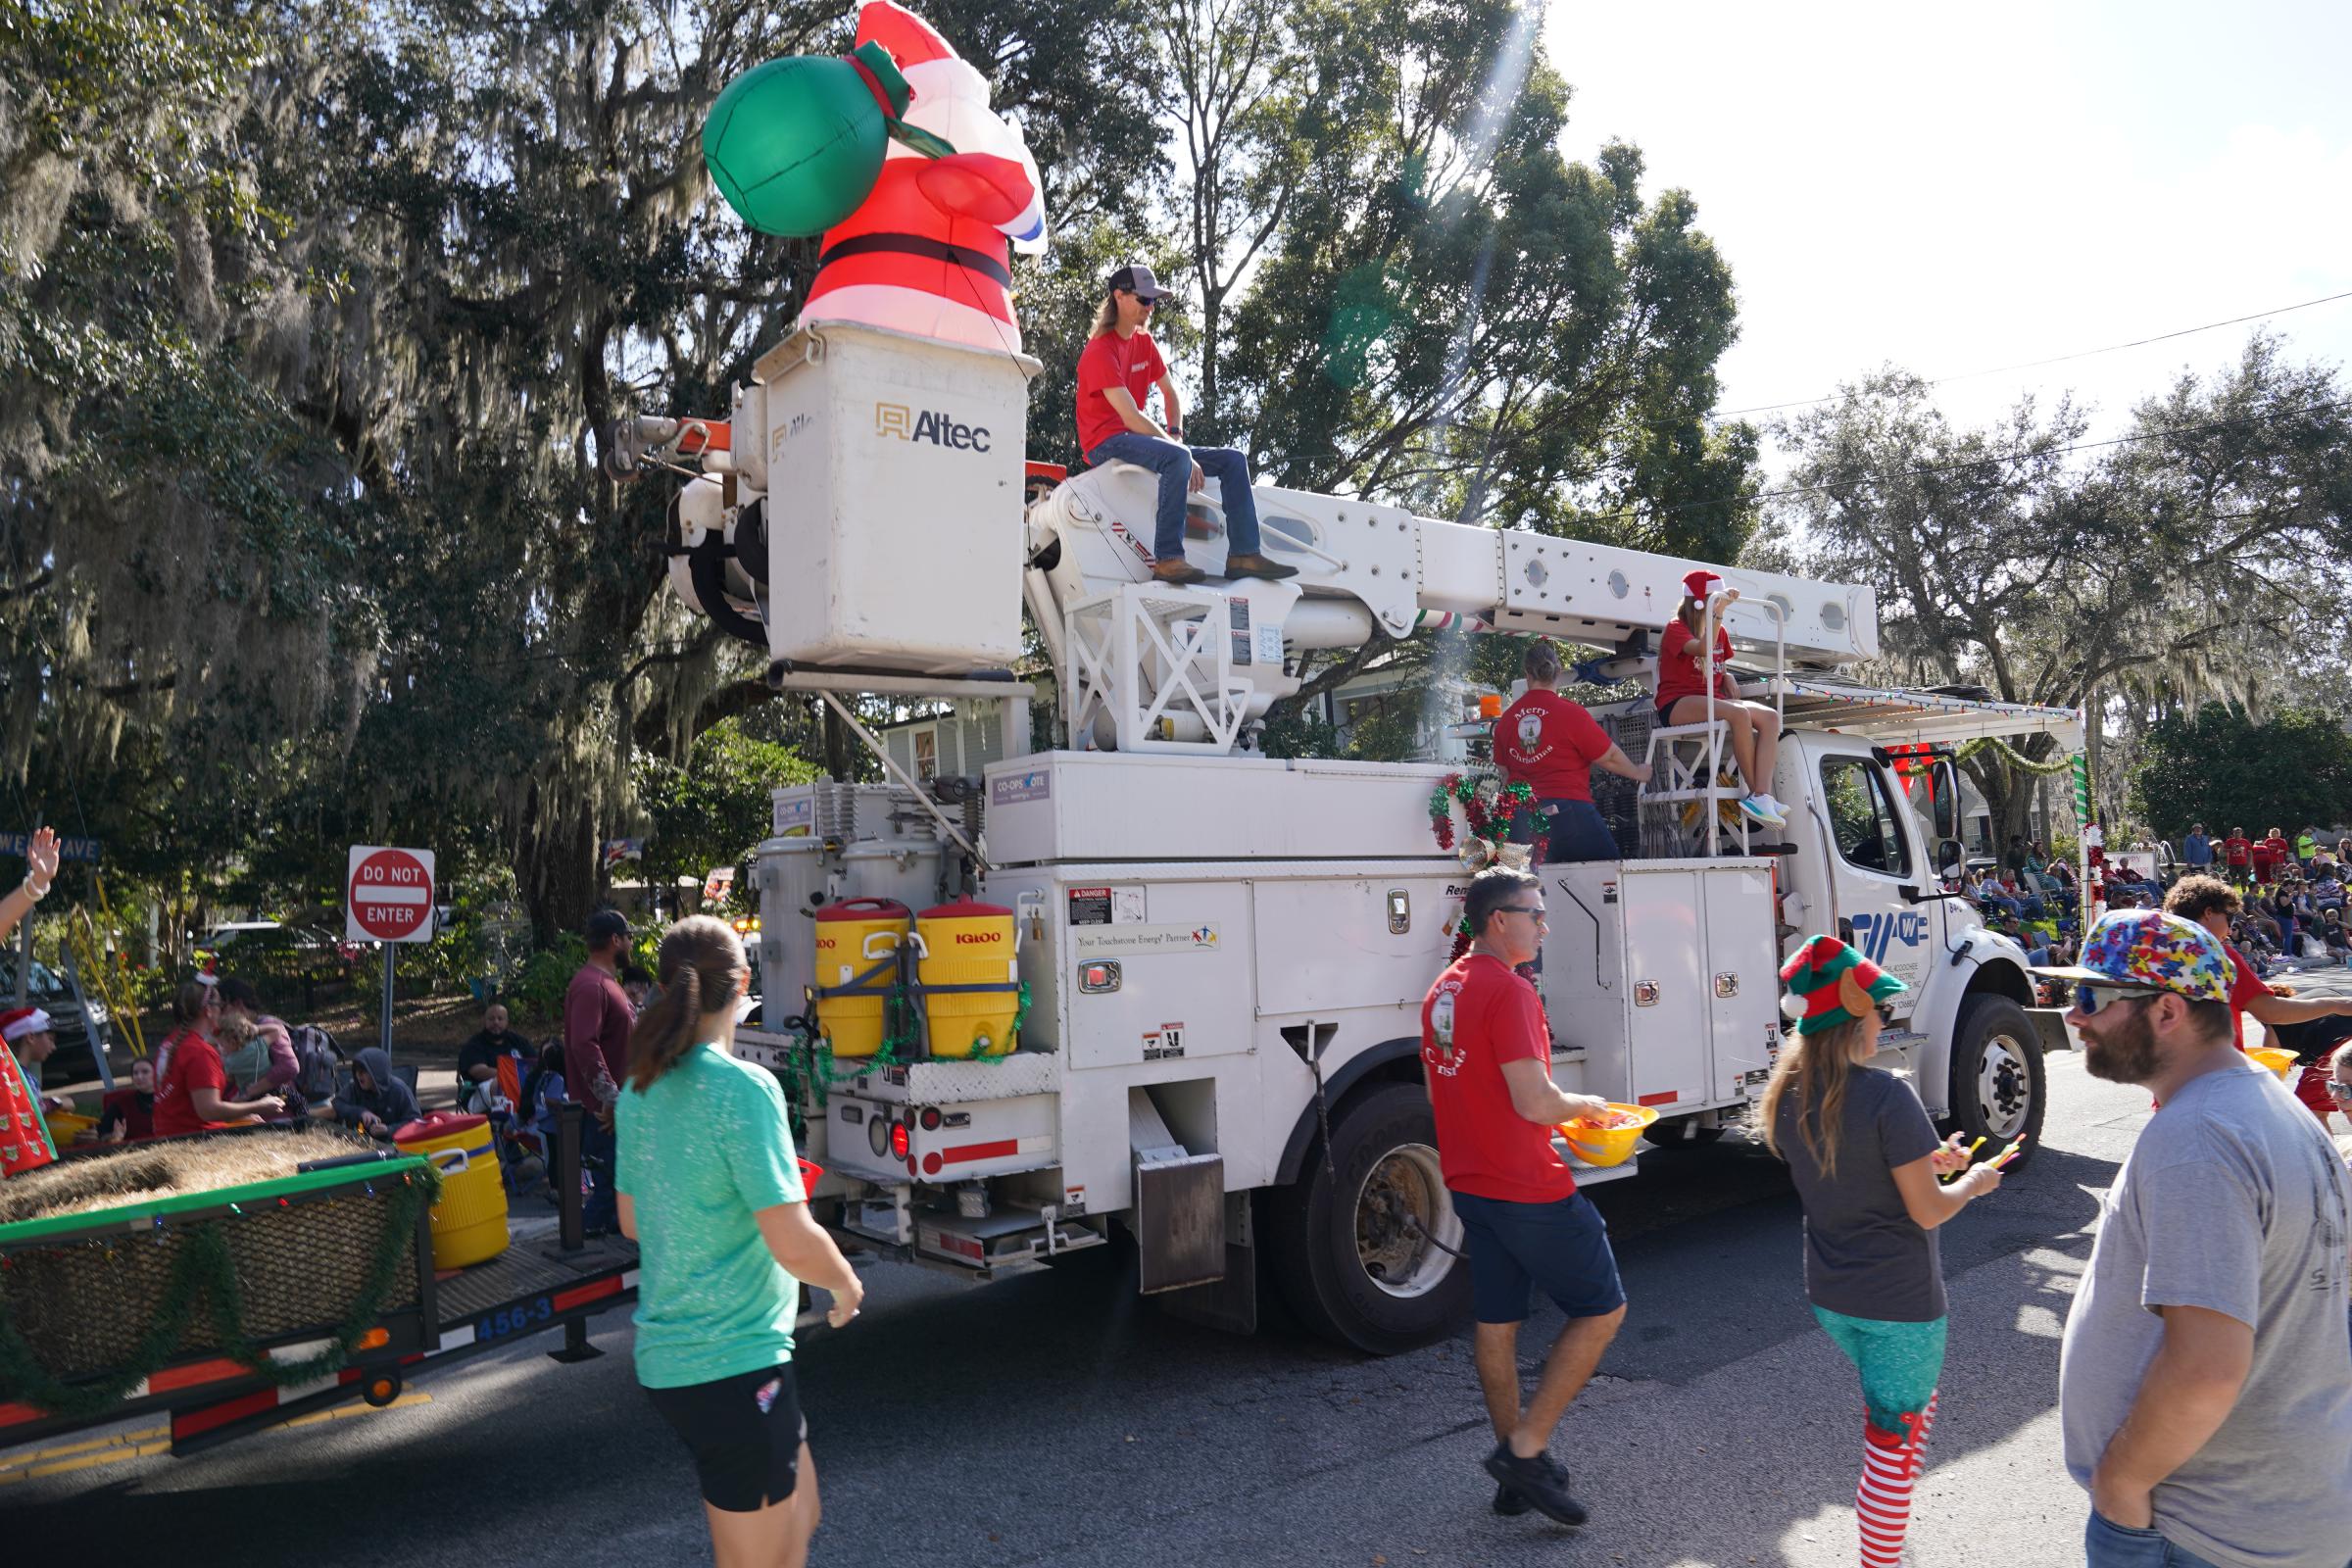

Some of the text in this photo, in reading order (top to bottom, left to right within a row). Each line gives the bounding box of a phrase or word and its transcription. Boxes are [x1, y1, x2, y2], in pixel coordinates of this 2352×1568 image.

[911, 410, 991, 454] Altec
[1514, 707, 1549, 720] Merry
[1509, 745, 1553, 764] Christmas
[63, 839, 98, 859] AVE
[364, 865, 421, 883] DO NOT
[368, 906, 415, 923] ENTER
[956, 933, 1003, 945] IGLOO
[1078, 937, 1095, 948] Your
[1098, 936, 1137, 947] Touchstone
[1165, 932, 1191, 943] Partner
[477, 1297, 553, 1342] 456-3
